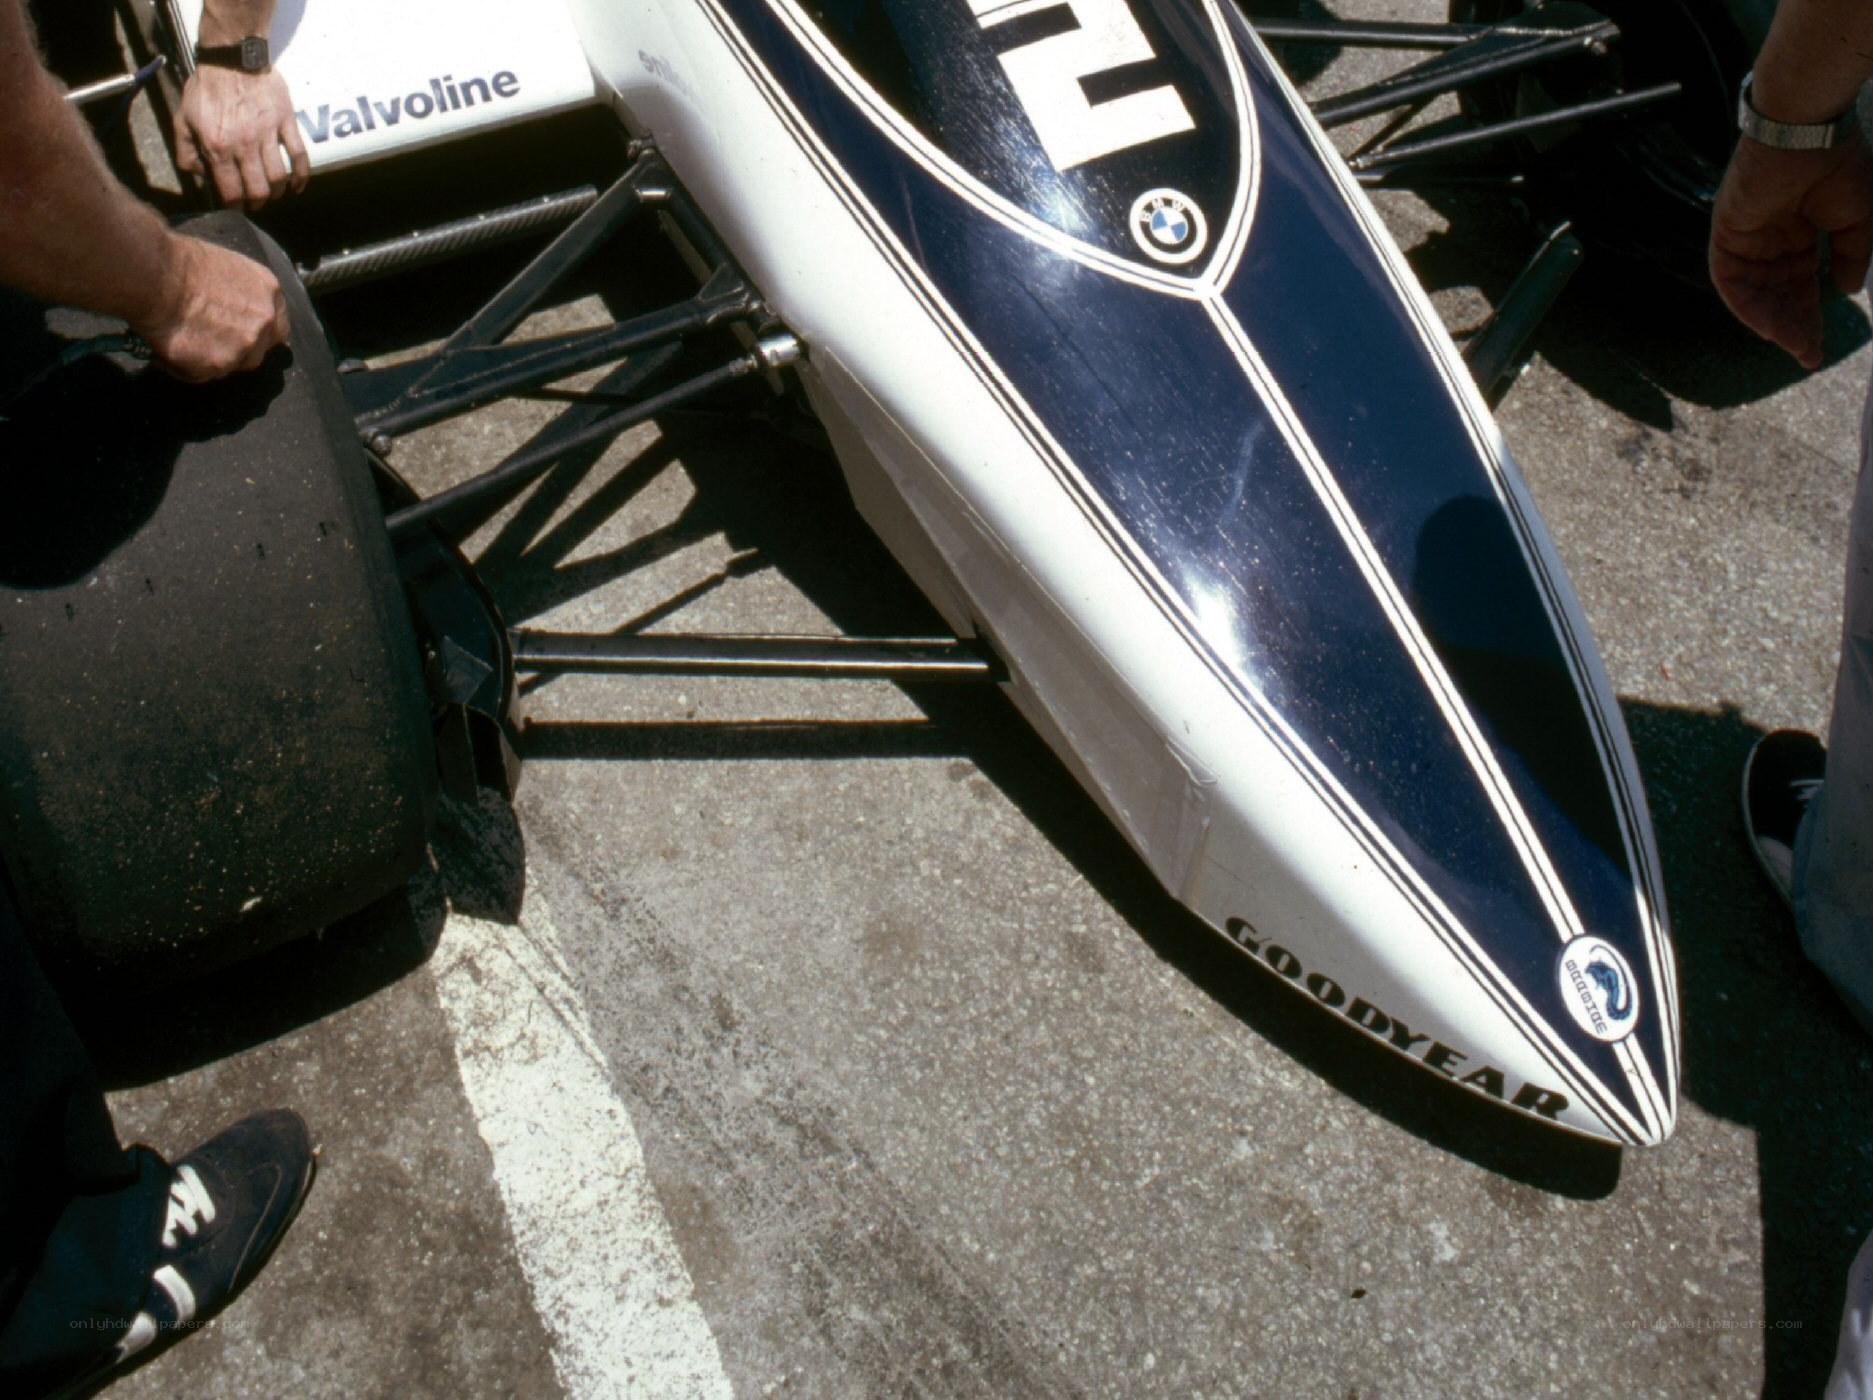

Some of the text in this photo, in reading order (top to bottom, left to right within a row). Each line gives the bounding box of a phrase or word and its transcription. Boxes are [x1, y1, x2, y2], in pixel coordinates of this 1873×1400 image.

[296, 69, 521, 143] Valvoline
[1140, 198, 1186, 223] BMW
[1225, 916, 1569, 1121] GOODYEAR
